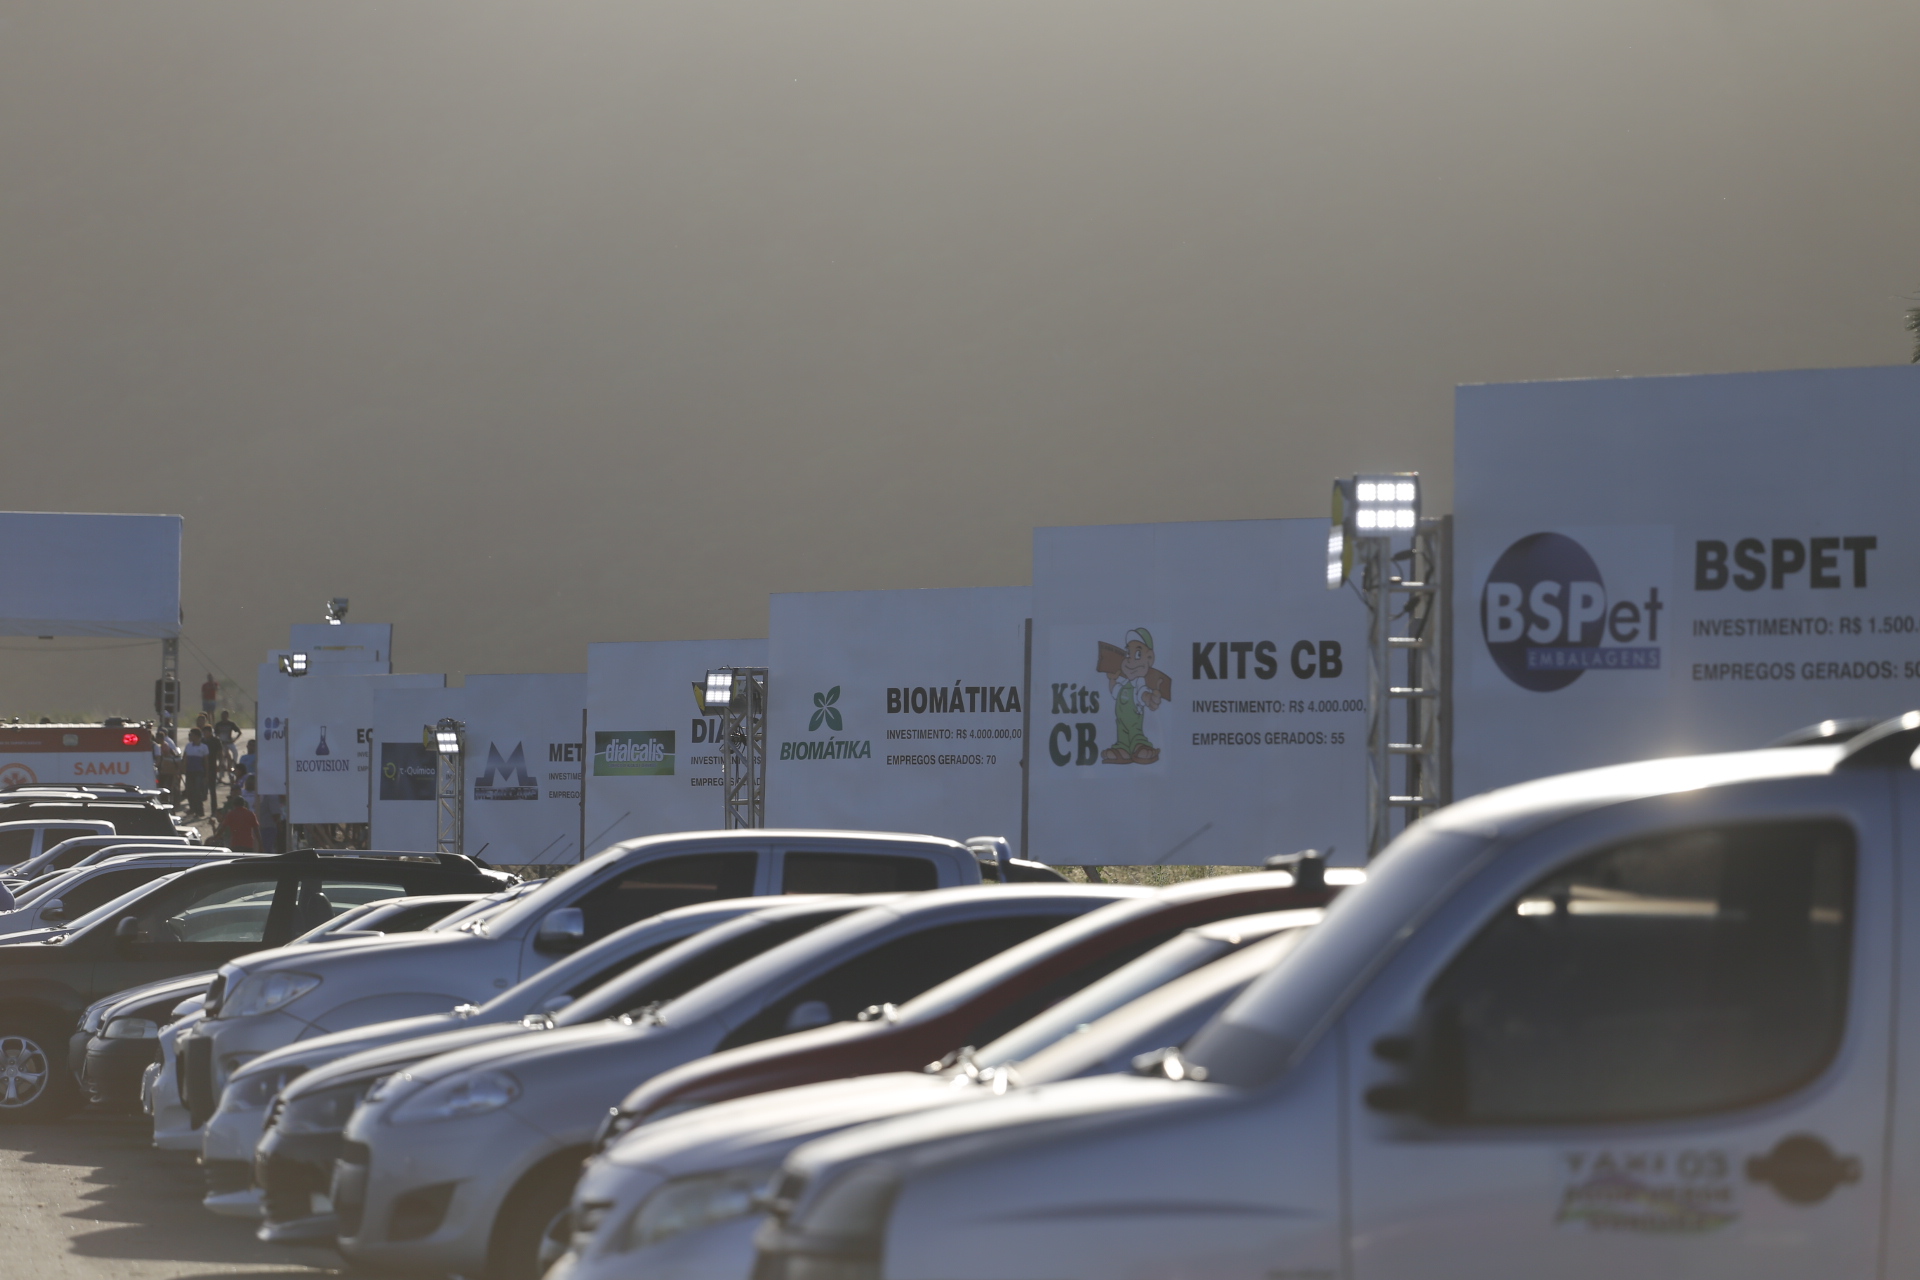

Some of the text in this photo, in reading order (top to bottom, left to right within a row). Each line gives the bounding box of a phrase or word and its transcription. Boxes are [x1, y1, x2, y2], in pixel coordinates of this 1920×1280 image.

[1694, 536, 1877, 592] BSPET
[1487, 580, 1664, 644] BSPet
[1693, 615, 1920, 637] INVESTIMENTO: R$ 1.500.
[1192, 640, 1343, 680] KITS CB
[1527, 651, 1658, 667] EMBALAGENS
[1692, 662, 1796, 681] EMPREGOS
[1801, 661, 1898, 680] GERADOS:
[886, 679, 1022, 714] BIOMÁTIKA
[1051, 683, 1100, 714] Kits
[1192, 700, 1286, 713] INVESTIMENTO:
[1289, 700, 1304, 714] R$
[886, 728, 1022, 740] INVESTIMENTO: R$ 4.000.000,00
[1192, 731, 1345, 745] EMPREGOS GERADOS: 55
[605, 738, 665, 762] dialcalis
[780, 736, 871, 761] BIOMÁTIKA
[1049, 722, 1099, 767] CB
[74, 762, 131, 775] SAMU
[296, 759, 350, 772] ECOVISION
[886, 754, 997, 765] EMPREGOS GERADOS: 70
[691, 777, 735, 787] EMPREGS
[549, 791, 582, 799] EMPREGO
